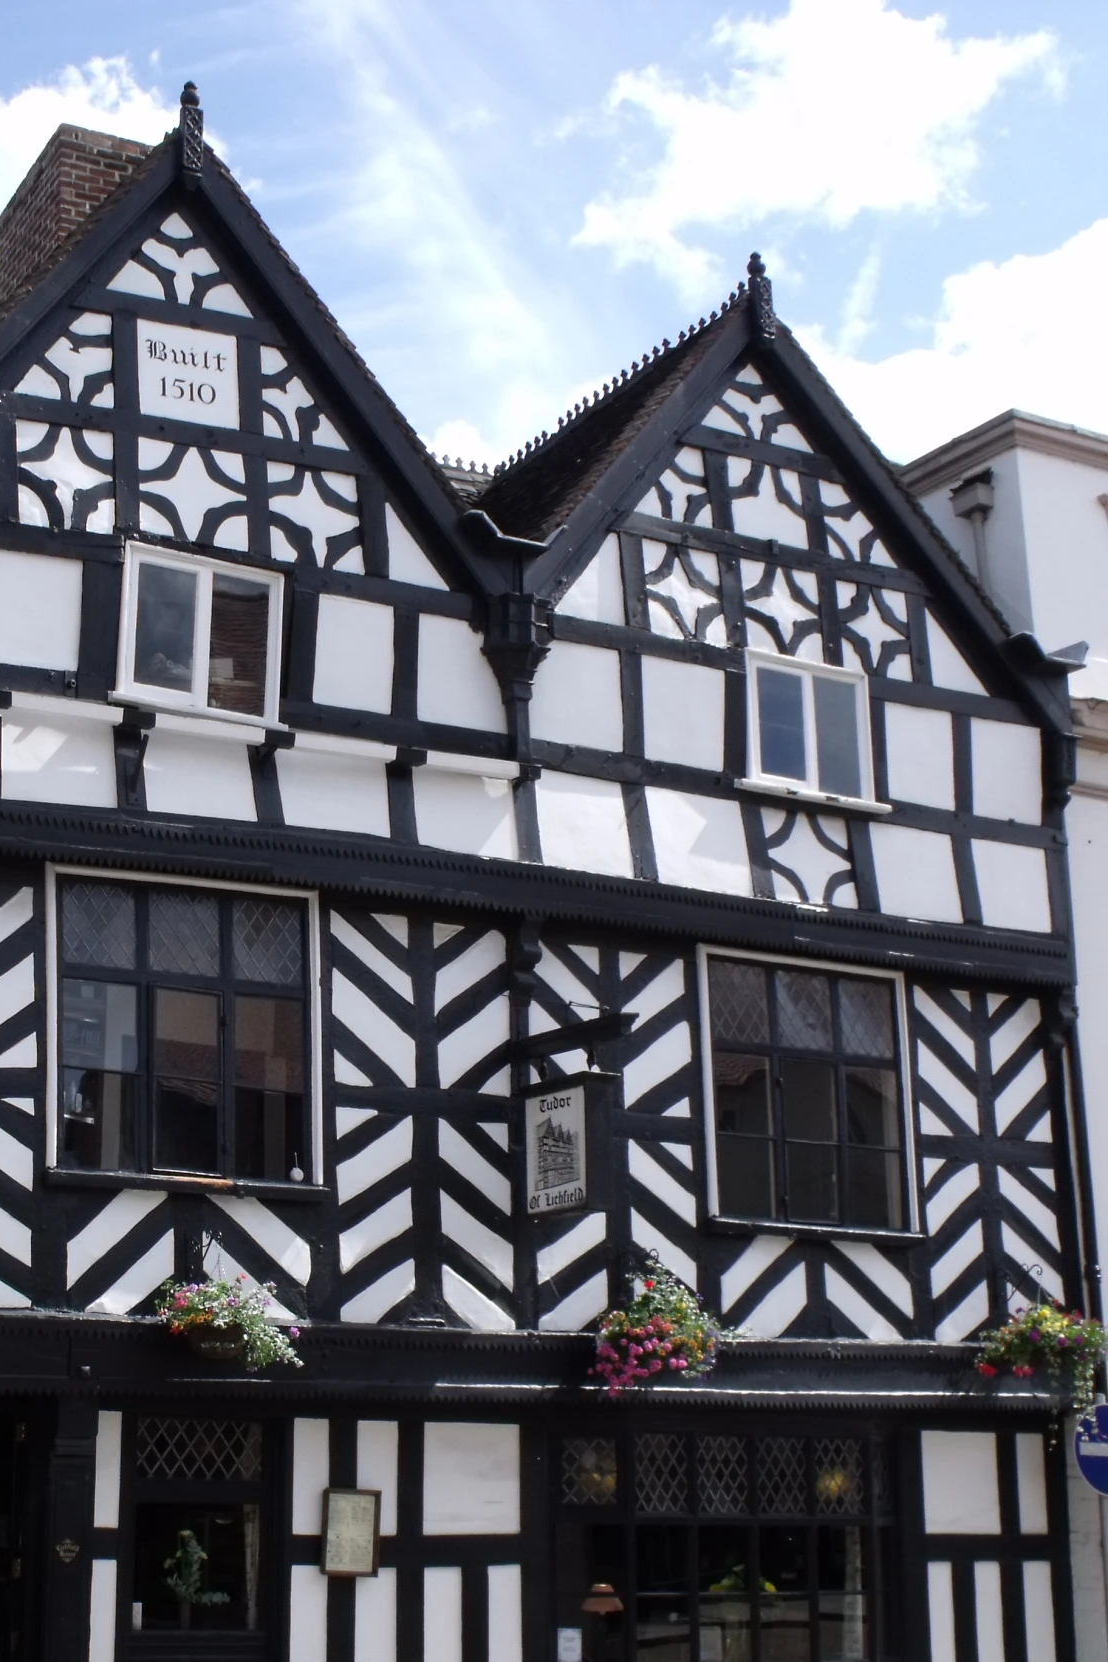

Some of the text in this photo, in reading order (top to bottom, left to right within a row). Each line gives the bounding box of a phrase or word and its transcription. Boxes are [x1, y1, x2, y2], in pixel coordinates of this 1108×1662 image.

[145, 338, 227, 373] Built
[160, 376, 217, 405] 1510
[539, 1095, 572, 1113] Tudor
[529, 1187, 584, 1210] Of Lichfield
